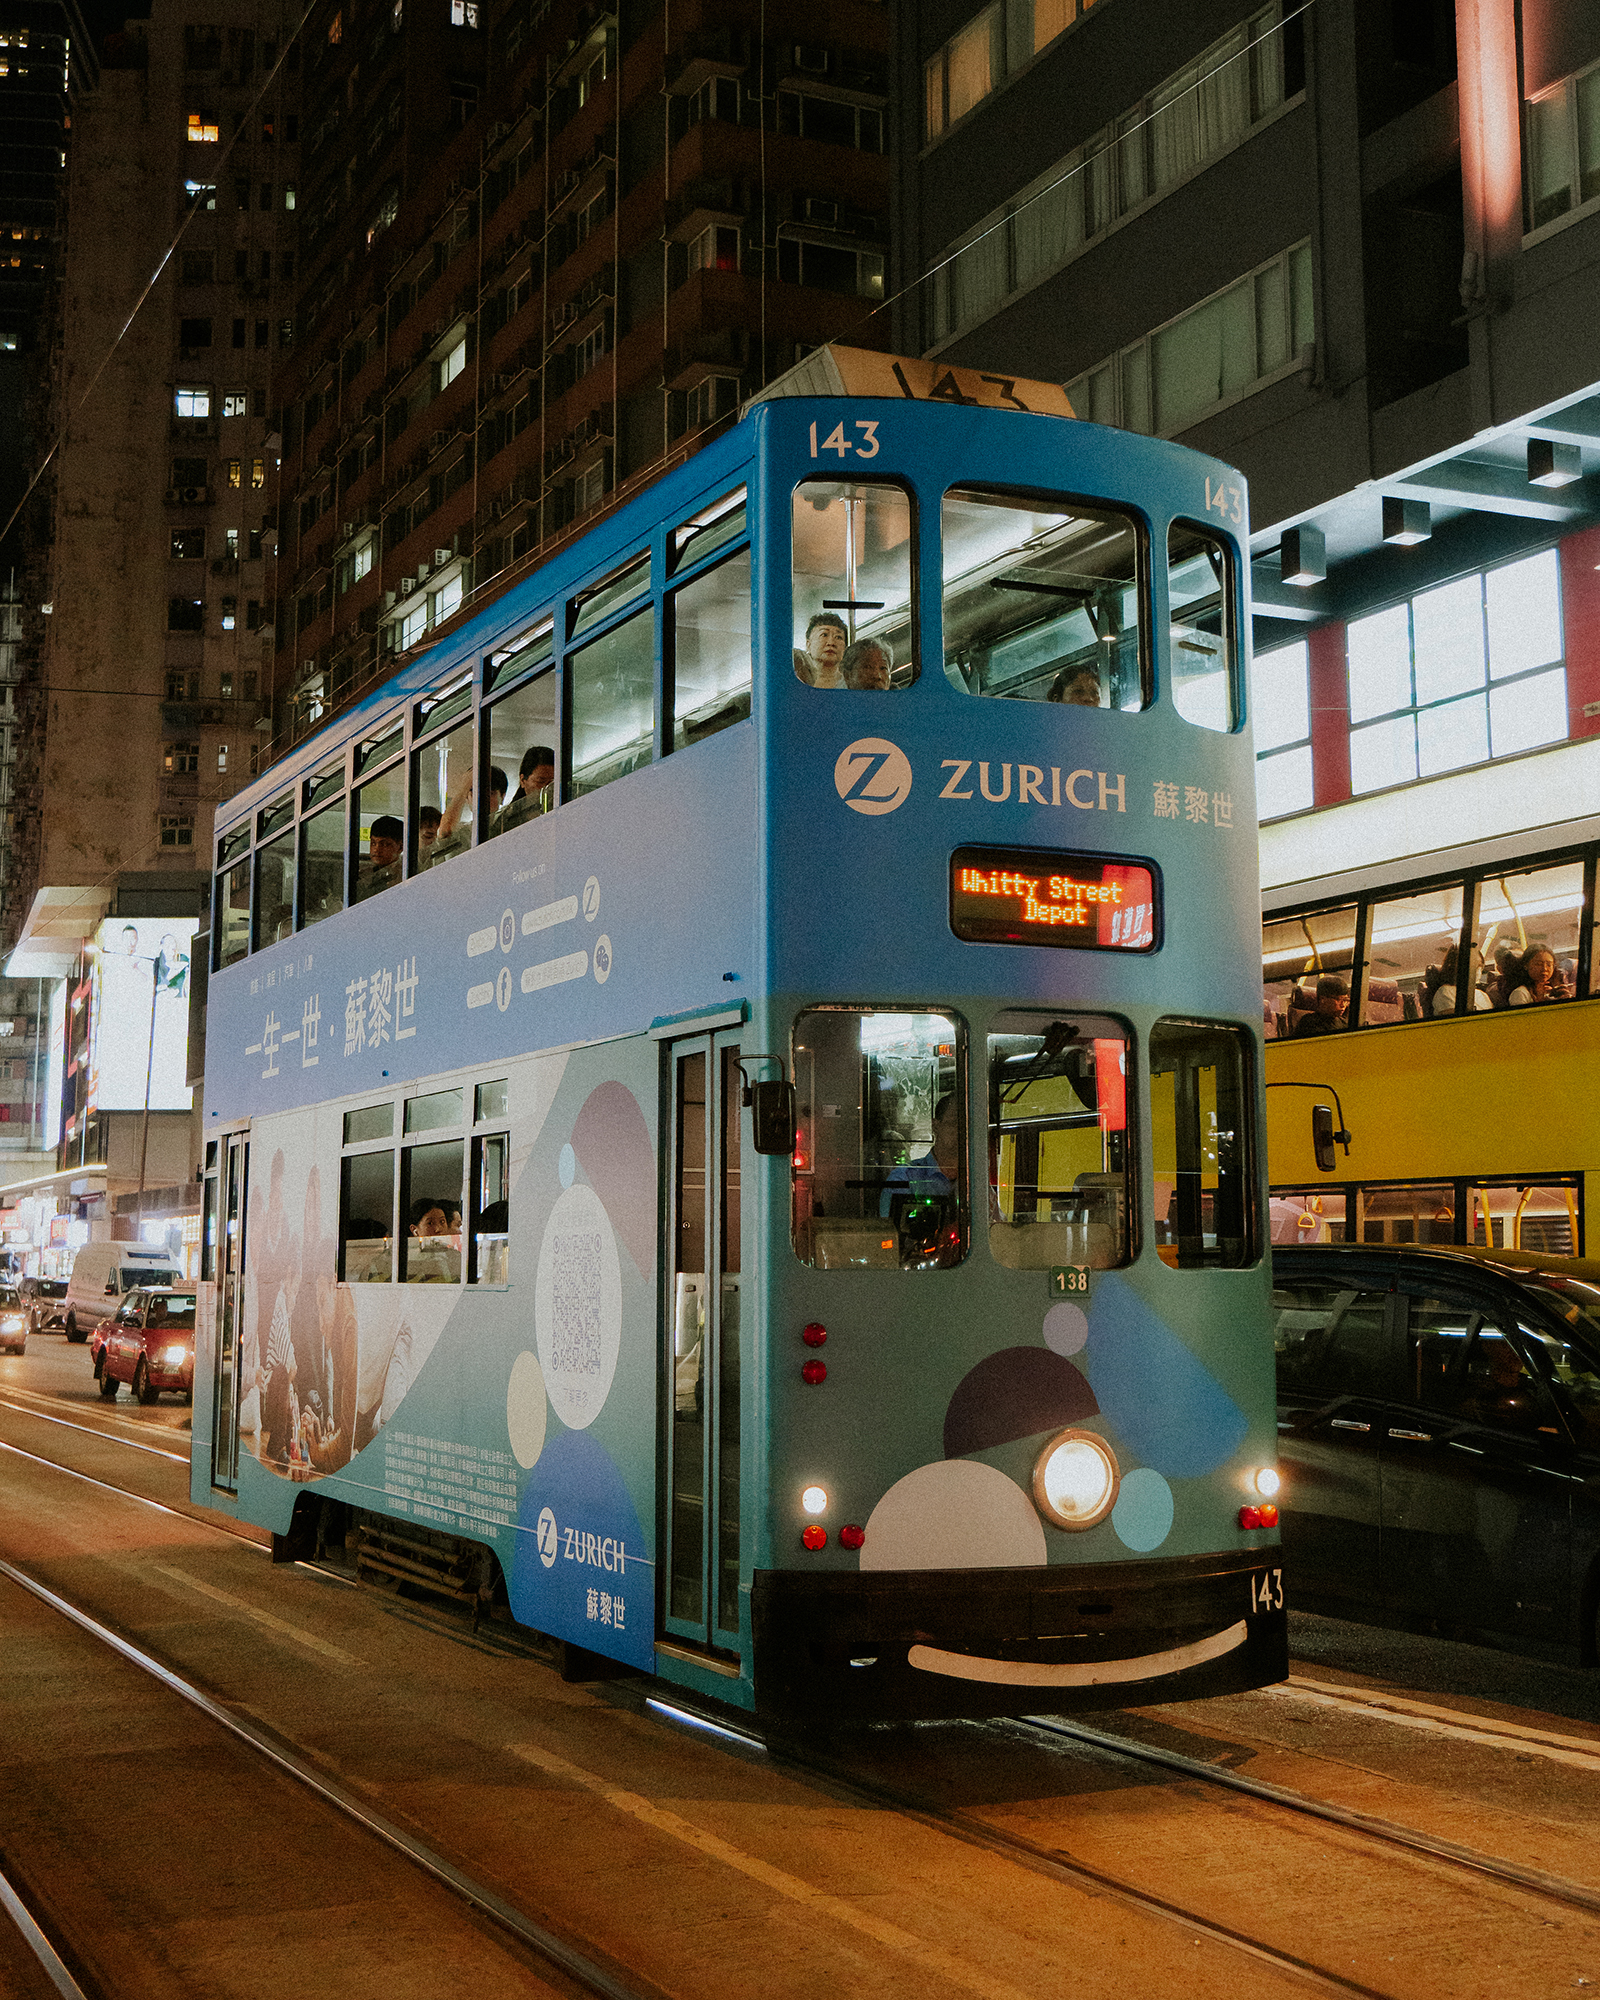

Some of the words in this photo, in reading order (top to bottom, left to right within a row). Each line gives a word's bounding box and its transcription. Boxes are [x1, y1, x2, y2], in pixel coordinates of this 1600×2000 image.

[810, 420, 880, 459] 143
[1204, 475, 1242, 525] 143
[938, 759, 1127, 813] ZURICH
[1152, 779, 1235, 830] 蘇黎世
[961, 867, 1039, 898] Whitty
[1049, 876, 1123, 904] Street
[1025, 898, 1087, 925] Depot
[1056, 1272, 1088, 1291] 138
[564, 1526, 626, 1575] ZURICH
[586, 1587, 626, 1630] 蘇黎世
[1251, 1568, 1284, 1614] 143
